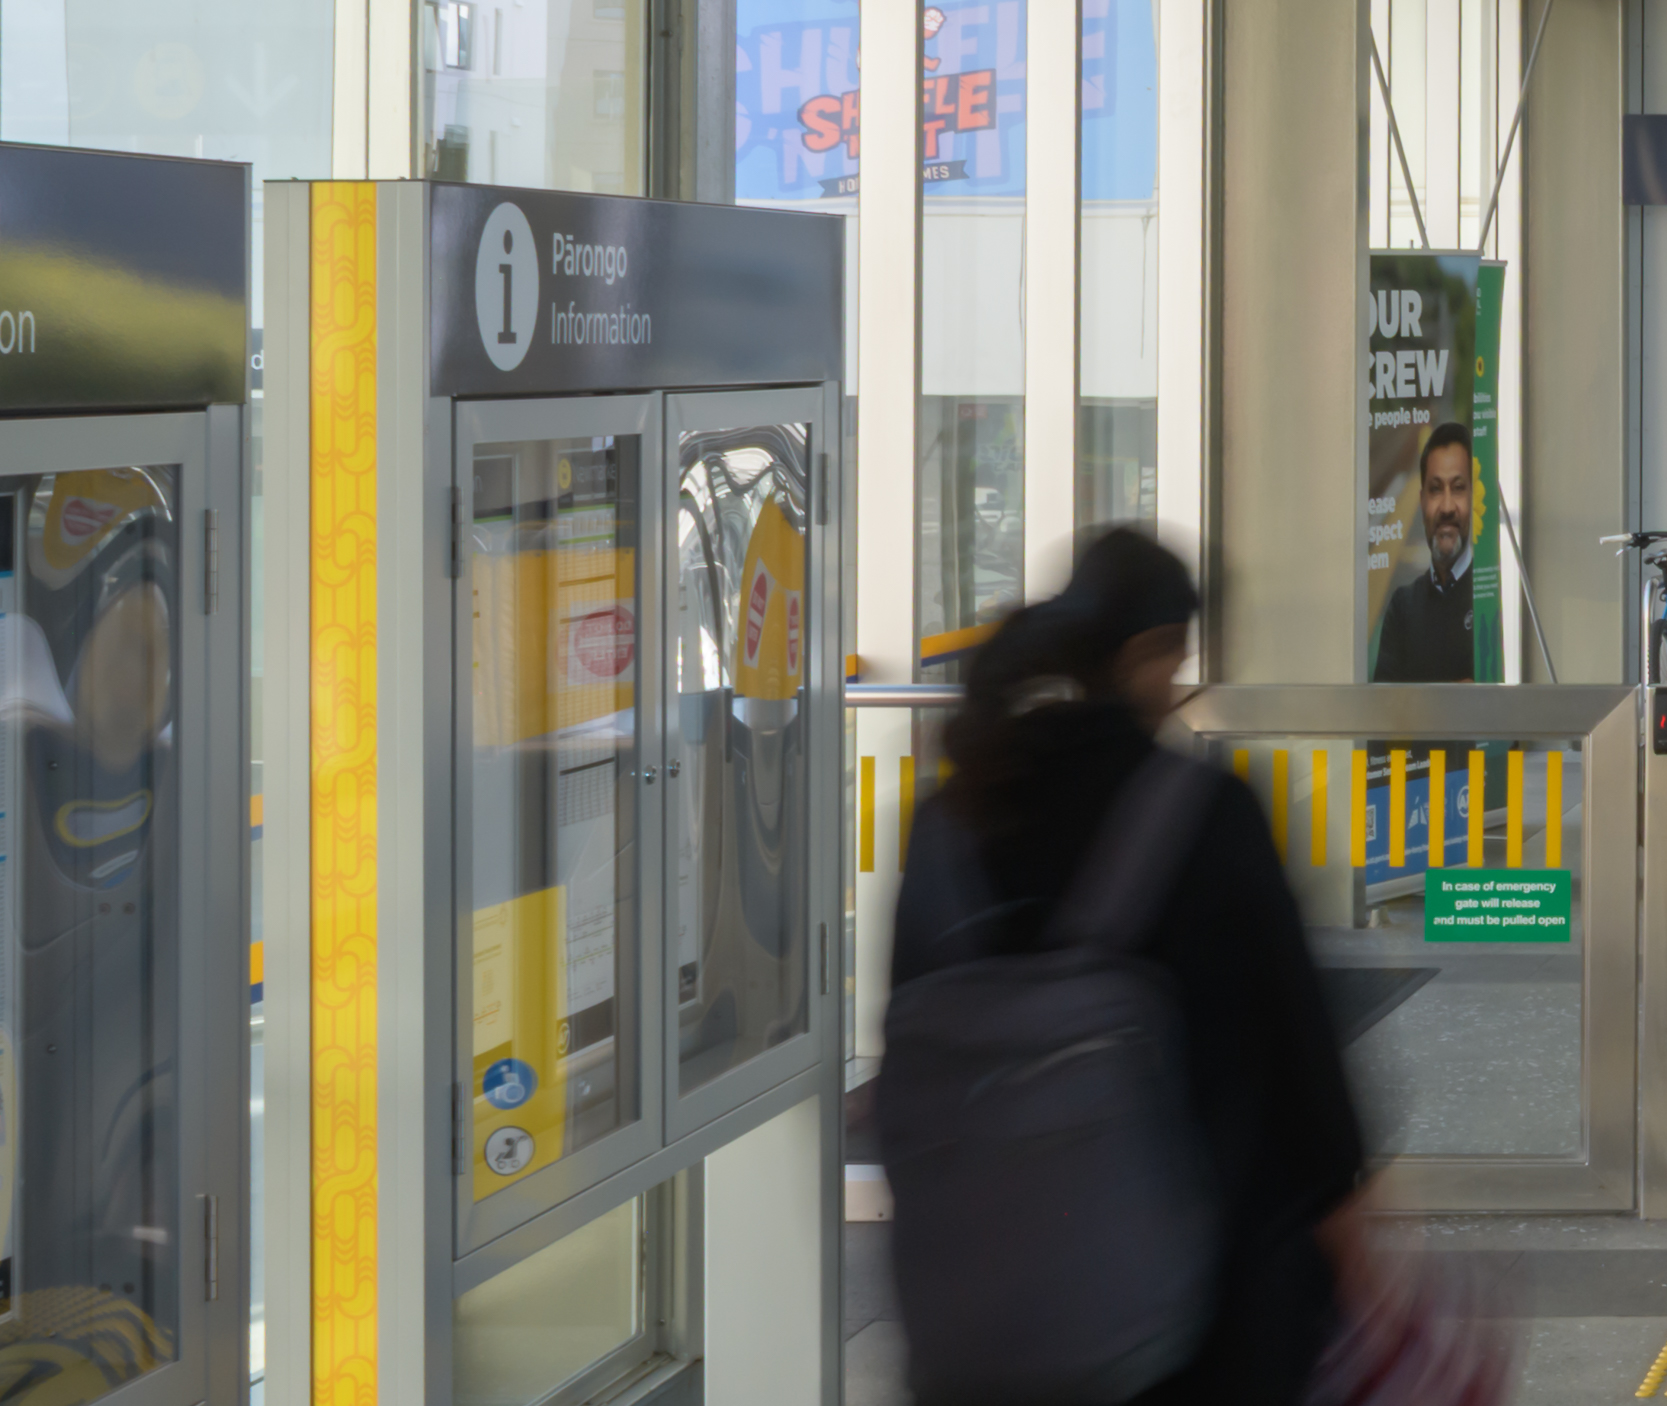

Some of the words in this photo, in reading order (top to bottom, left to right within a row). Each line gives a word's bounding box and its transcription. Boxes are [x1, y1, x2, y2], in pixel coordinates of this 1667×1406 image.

[552, 232, 628, 285] Pārongo
[551, 301, 652, 345] Information
[1374, 407, 1411, 429] people
[1413, 407, 1430, 424] too
[1368, 497, 1396, 514] ease
[1369, 520, 1403, 545] spect
[1442, 881, 1452, 891] In
[1455, 883, 1480, 891] case
[1483, 881, 1495, 891] of
[1496, 882, 1556, 893] emergency
[1455, 899, 1479, 910] gate
[1481, 898, 1500, 908] will
[1501, 898, 1541, 908] release
[1433, 915, 1454, 925] and
[1457, 916, 1484, 925] must
[1486, 915, 1500, 925] be
[1502, 915, 1536, 927] pulled
[1538, 917, 1566, 927] open
